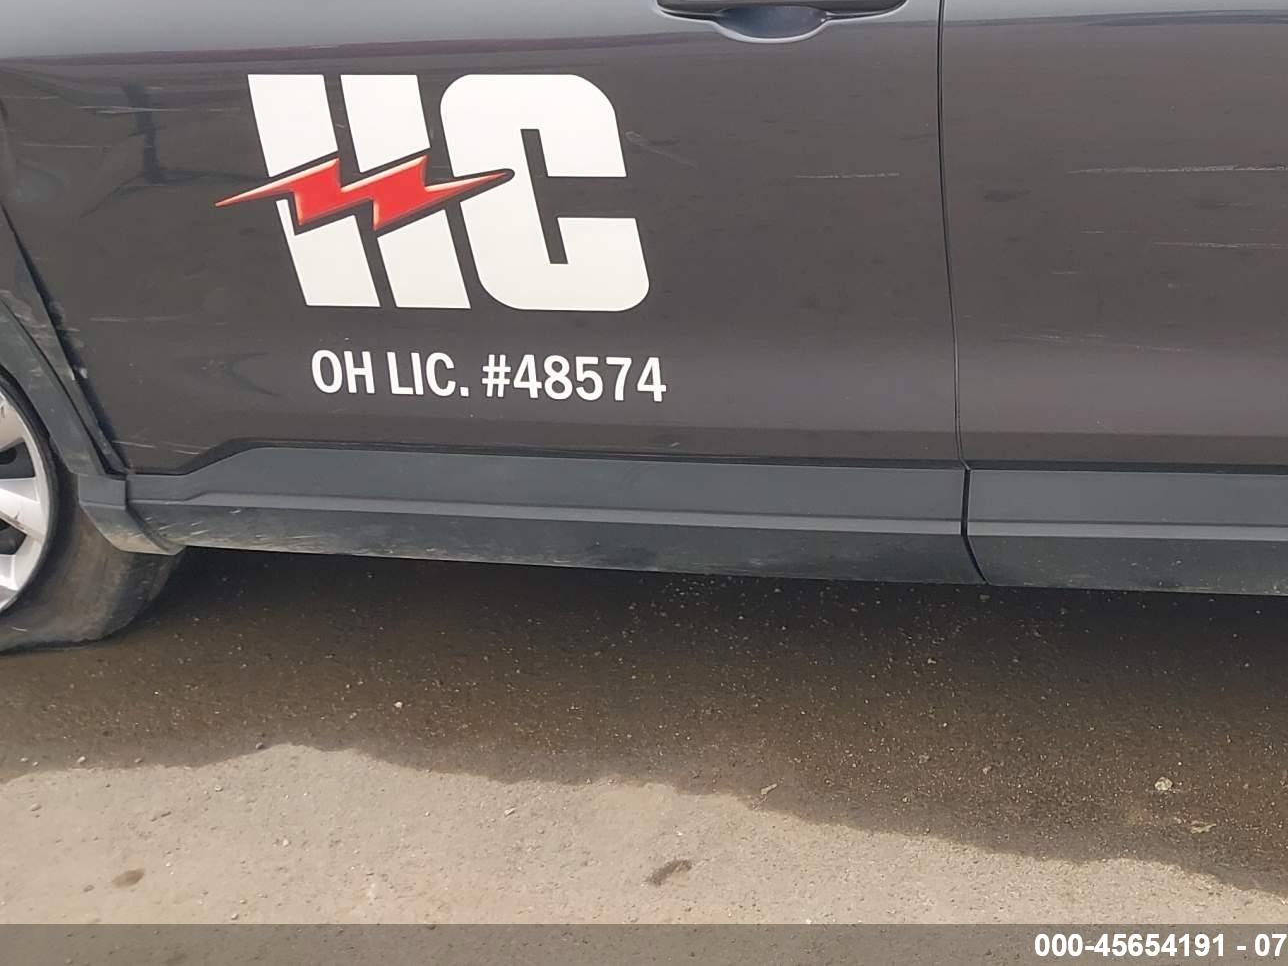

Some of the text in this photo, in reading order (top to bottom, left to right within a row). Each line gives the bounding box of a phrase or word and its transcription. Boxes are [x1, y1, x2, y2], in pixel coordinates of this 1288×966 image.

[312, 350, 666, 401] OH LIC. #48574
